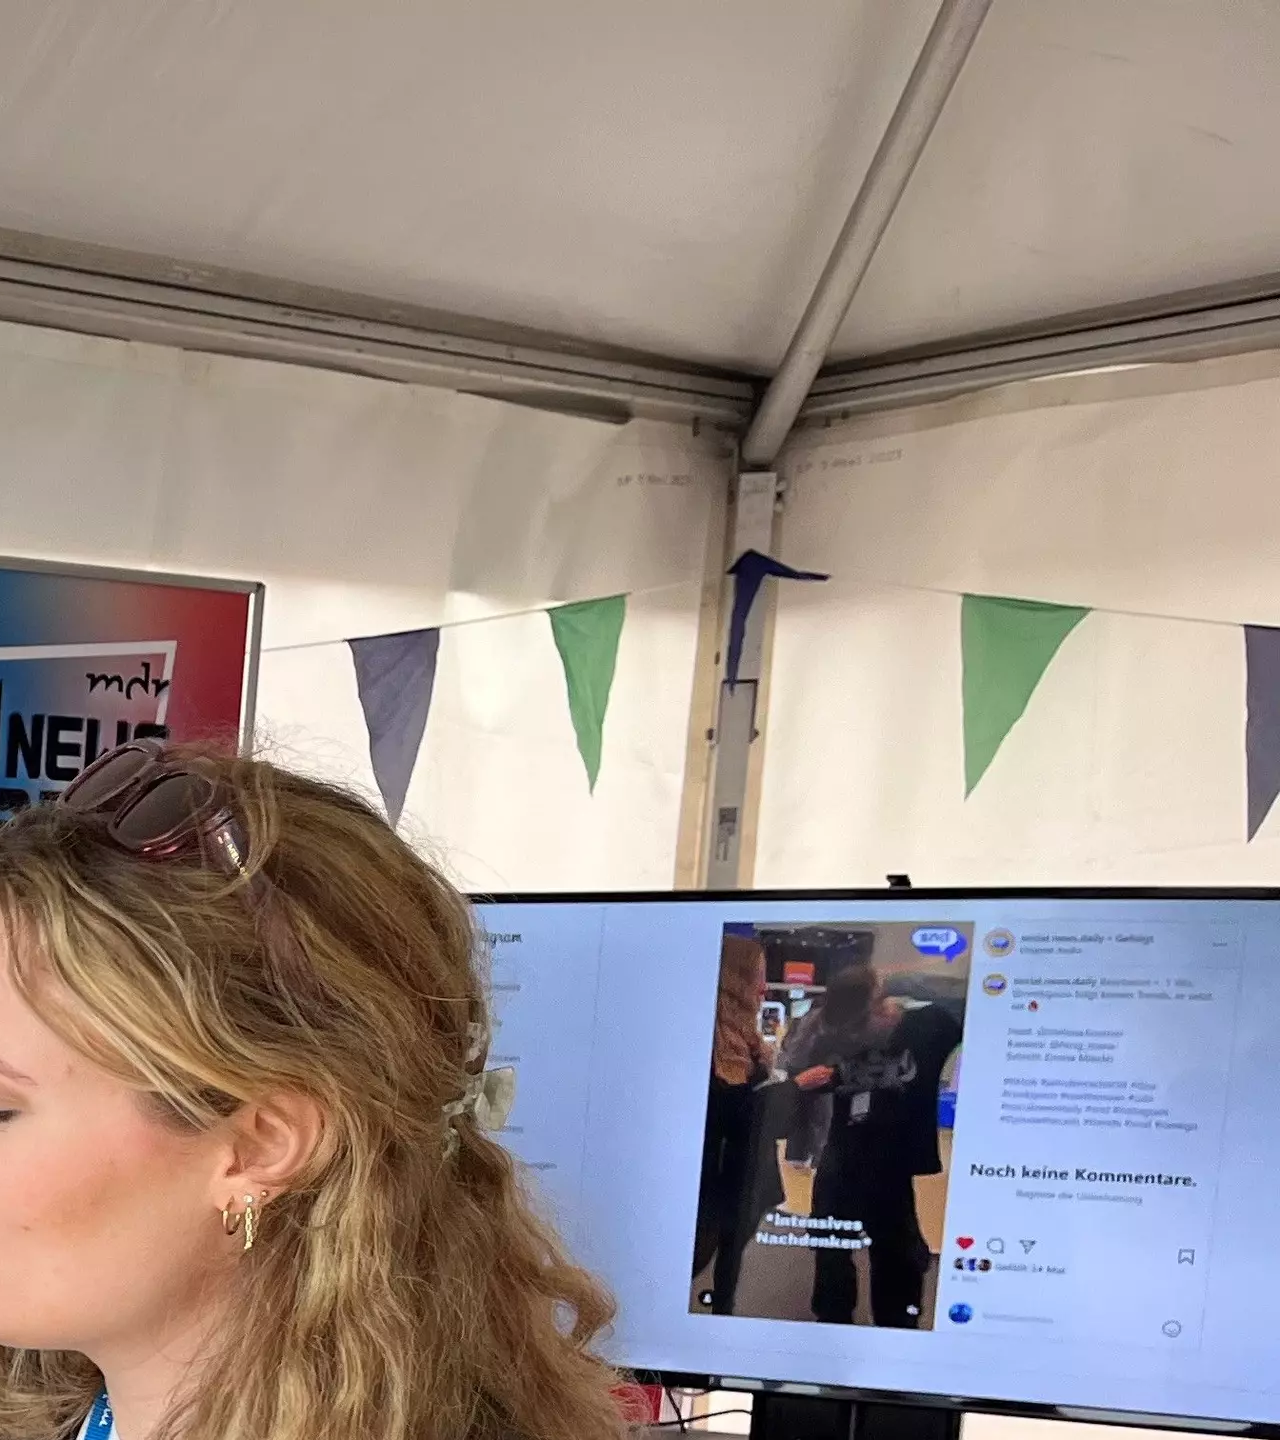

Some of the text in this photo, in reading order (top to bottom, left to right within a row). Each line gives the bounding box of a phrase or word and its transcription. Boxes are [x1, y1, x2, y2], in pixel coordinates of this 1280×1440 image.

[85, 662, 170, 700] mdr
[969, 1163, 1197, 1187] Noch keine Kommentare.
